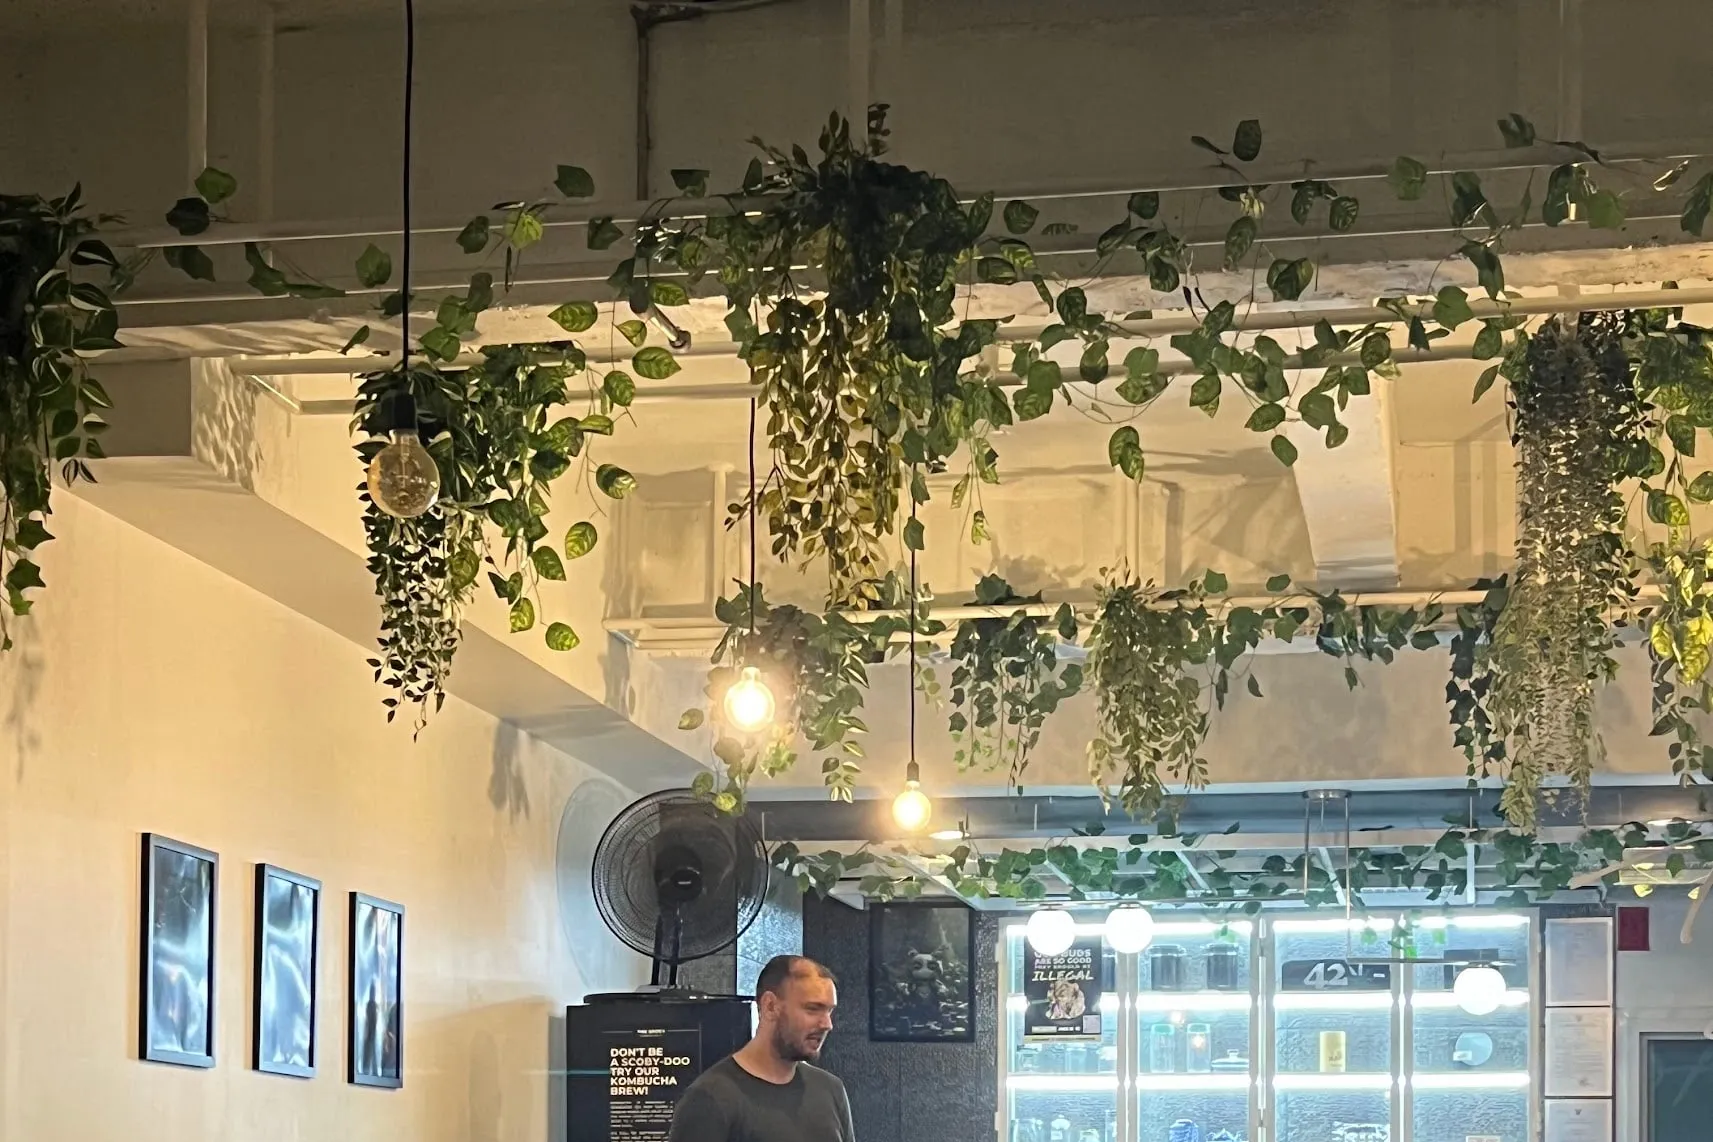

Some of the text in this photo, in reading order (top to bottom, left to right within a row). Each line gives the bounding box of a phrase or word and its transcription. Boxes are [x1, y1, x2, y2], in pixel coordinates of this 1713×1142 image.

[1032, 970, 1094, 981] ILLEGAL
[610, 1047, 663, 1057] DON'T BE
[610, 1057, 690, 1066] A SCOBY-DOO
[610, 1067, 659, 1076] TRY OUR
[610, 1076, 677, 1086] KOMBUCHA
[610, 1087, 648, 1095] BREW!
